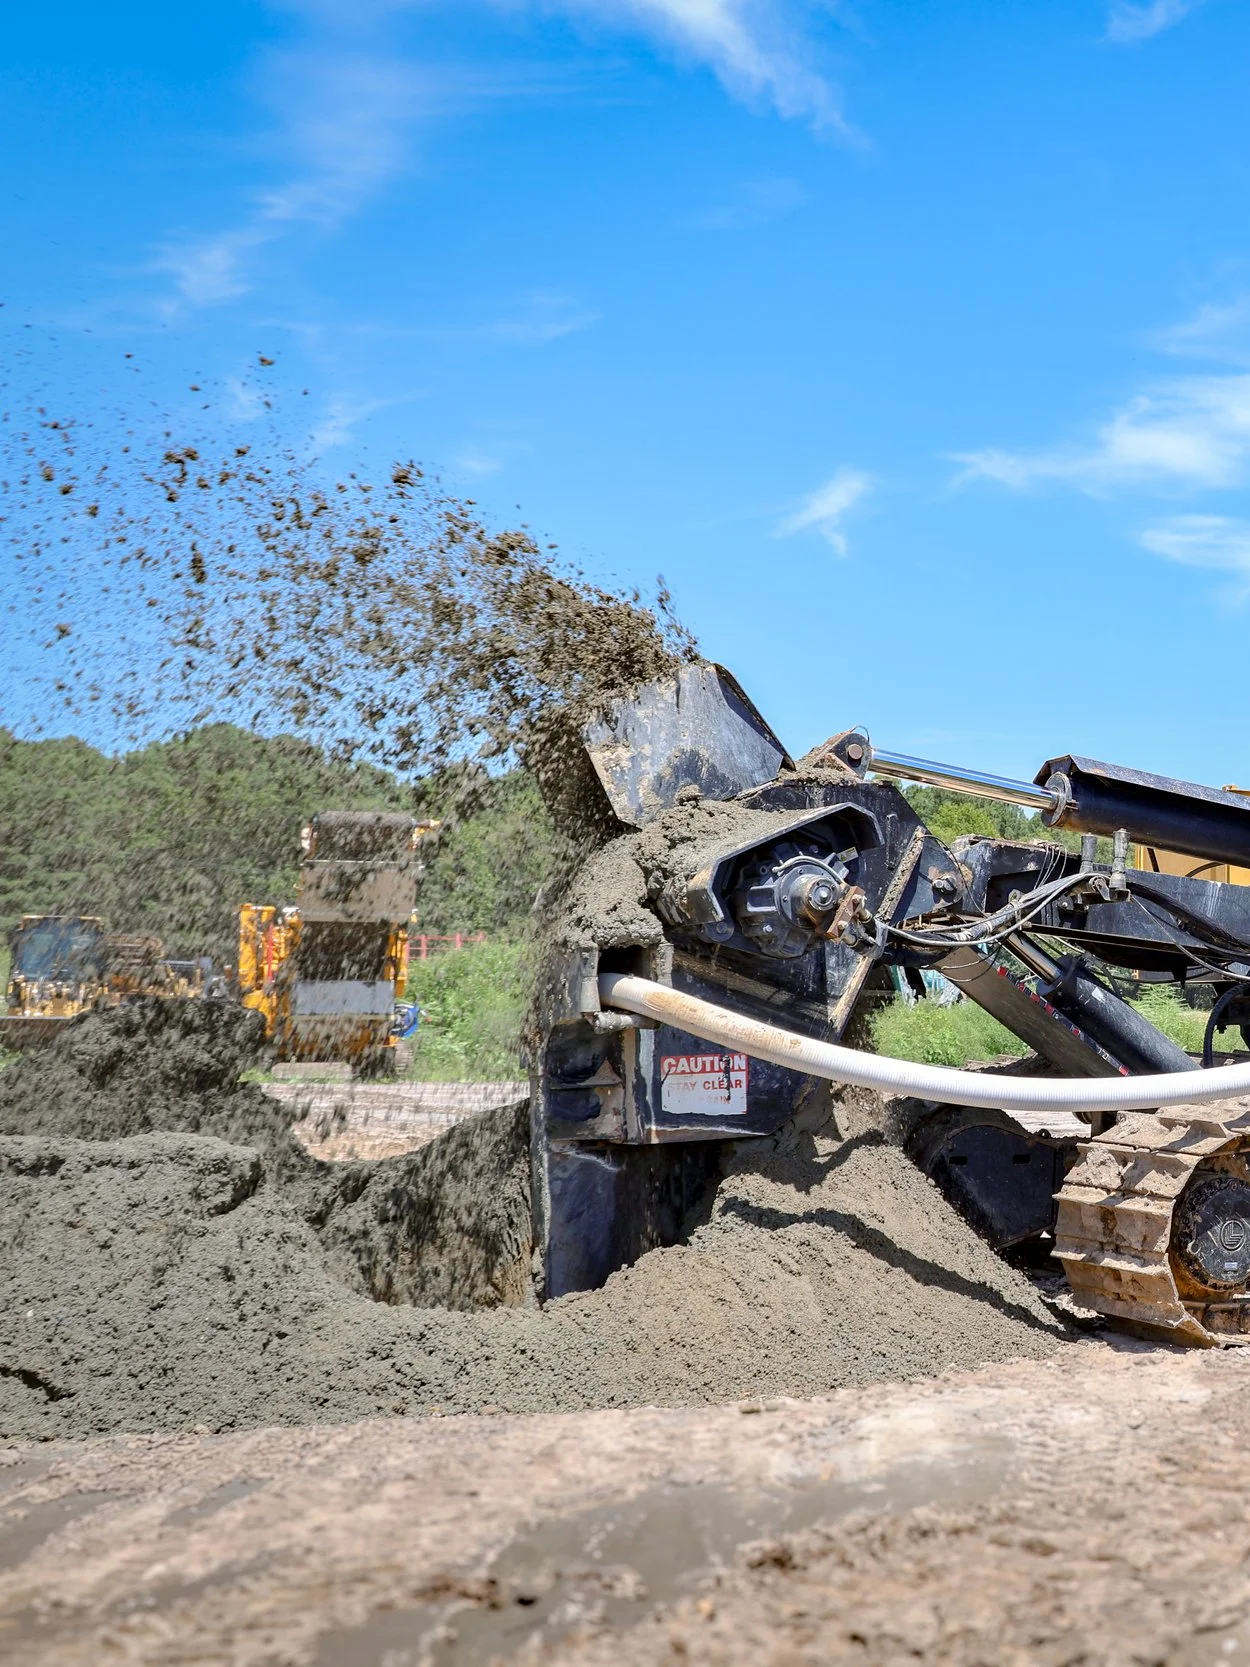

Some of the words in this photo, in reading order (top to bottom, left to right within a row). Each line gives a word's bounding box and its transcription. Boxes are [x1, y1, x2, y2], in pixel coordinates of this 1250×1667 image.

[663, 1055, 746, 1073] CAUTION
[668, 1081, 697, 1092] TAY
[703, 1079, 742, 1091] CLEAR
